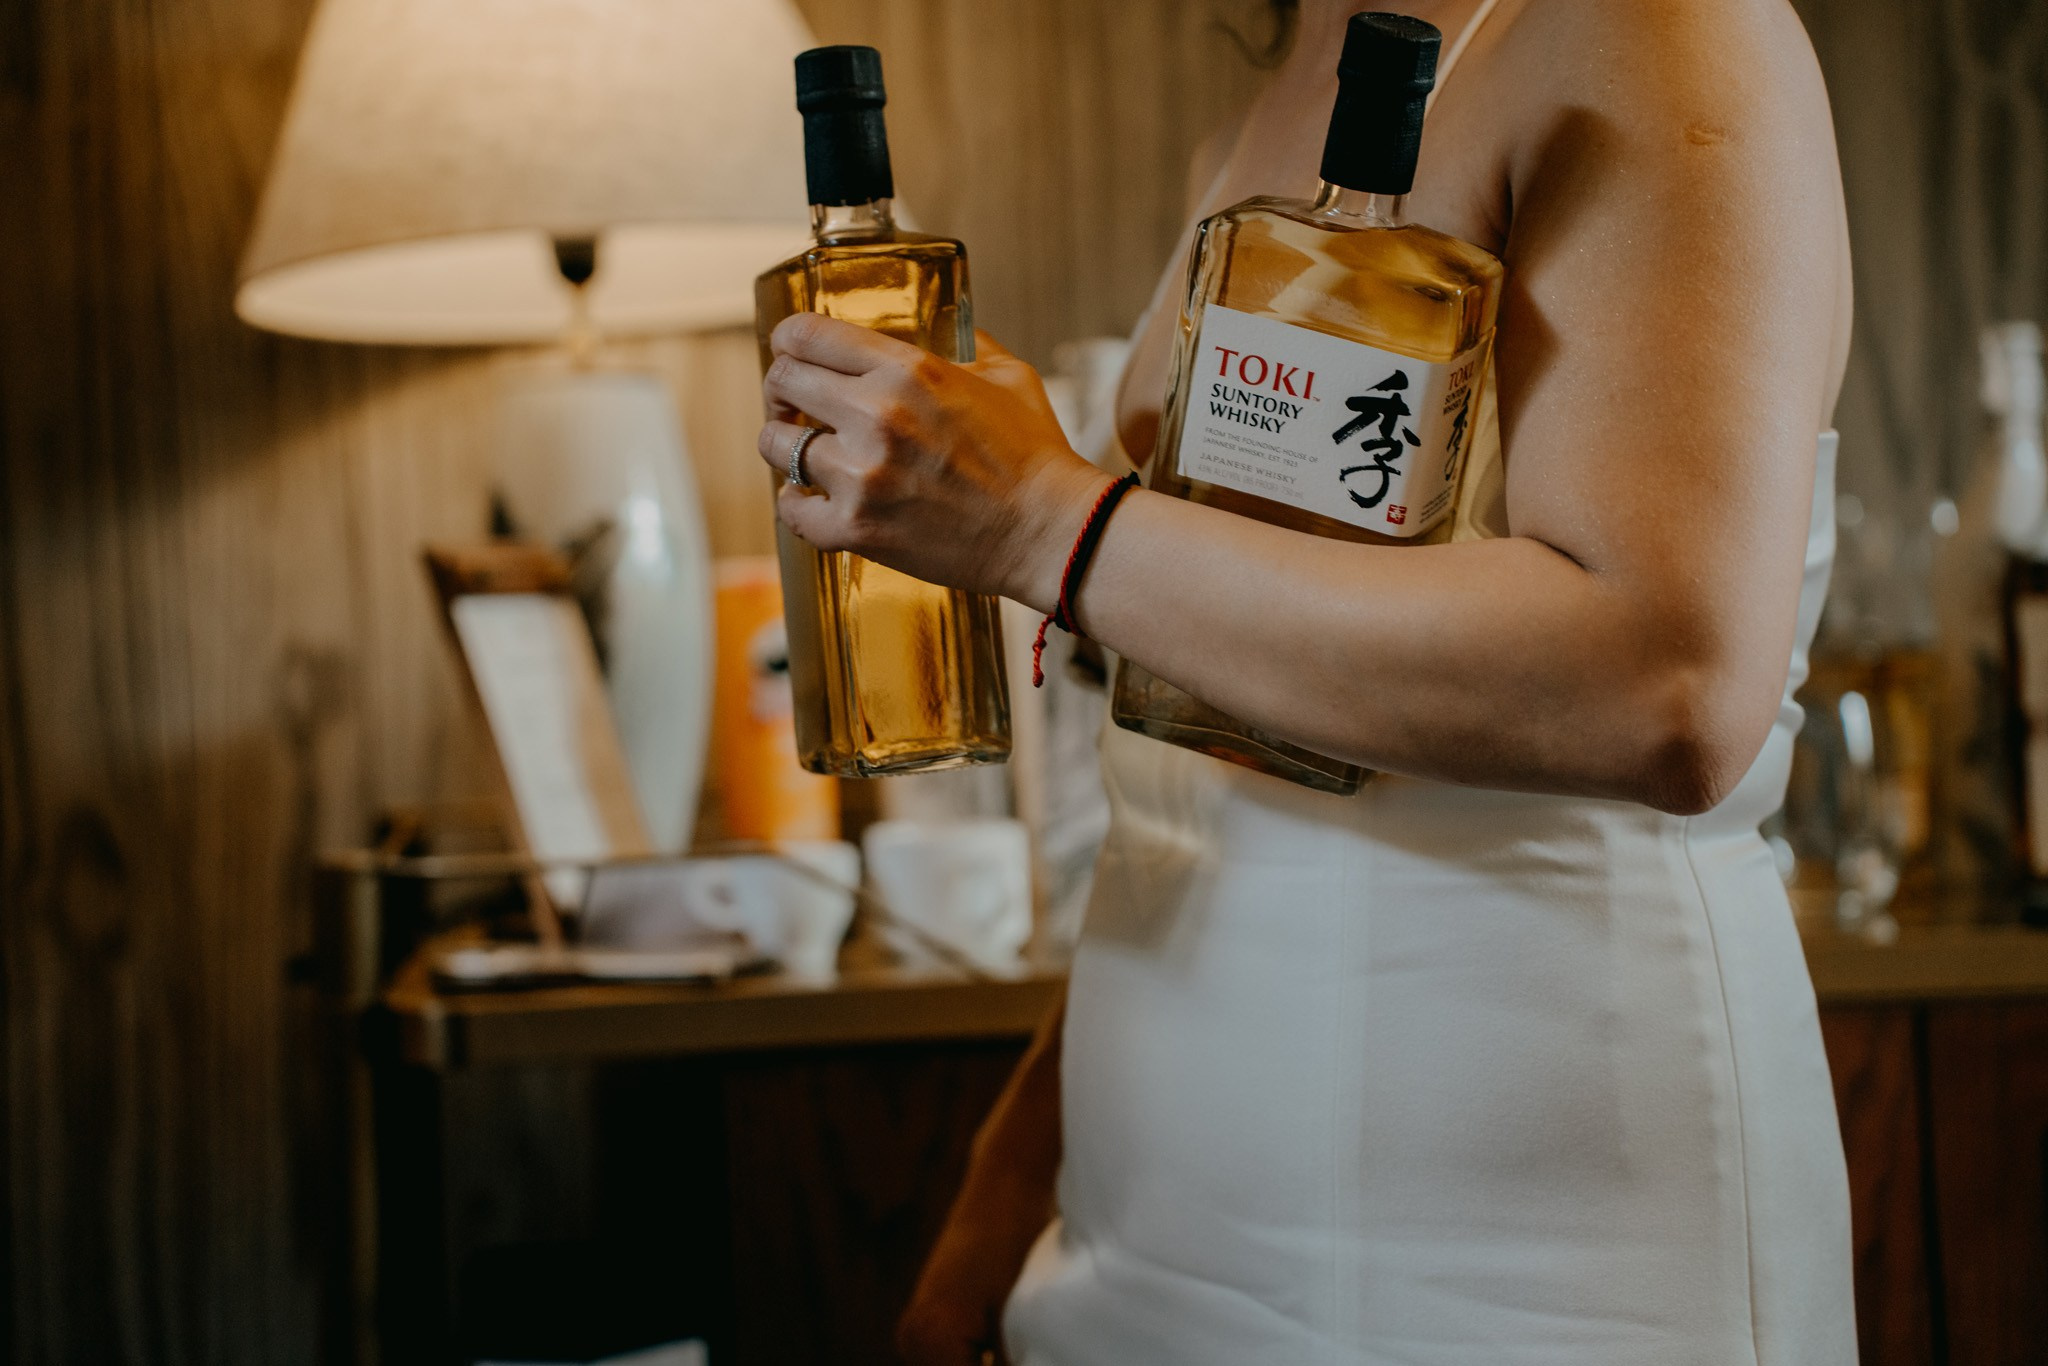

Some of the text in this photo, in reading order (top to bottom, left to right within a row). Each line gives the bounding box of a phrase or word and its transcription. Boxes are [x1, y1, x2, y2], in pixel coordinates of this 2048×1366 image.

[1215, 346, 1315, 400] TOKI
[1209, 401, 1286, 434] WHISKY
[1211, 383, 1303, 420] SUNTORY
[1203, 436, 1237, 451] JAPANESE
[1205, 426, 1319, 464] FROM THE FOUNDING HOUSE OF
[1200, 452, 1298, 485] JAPANESE WHISKY
